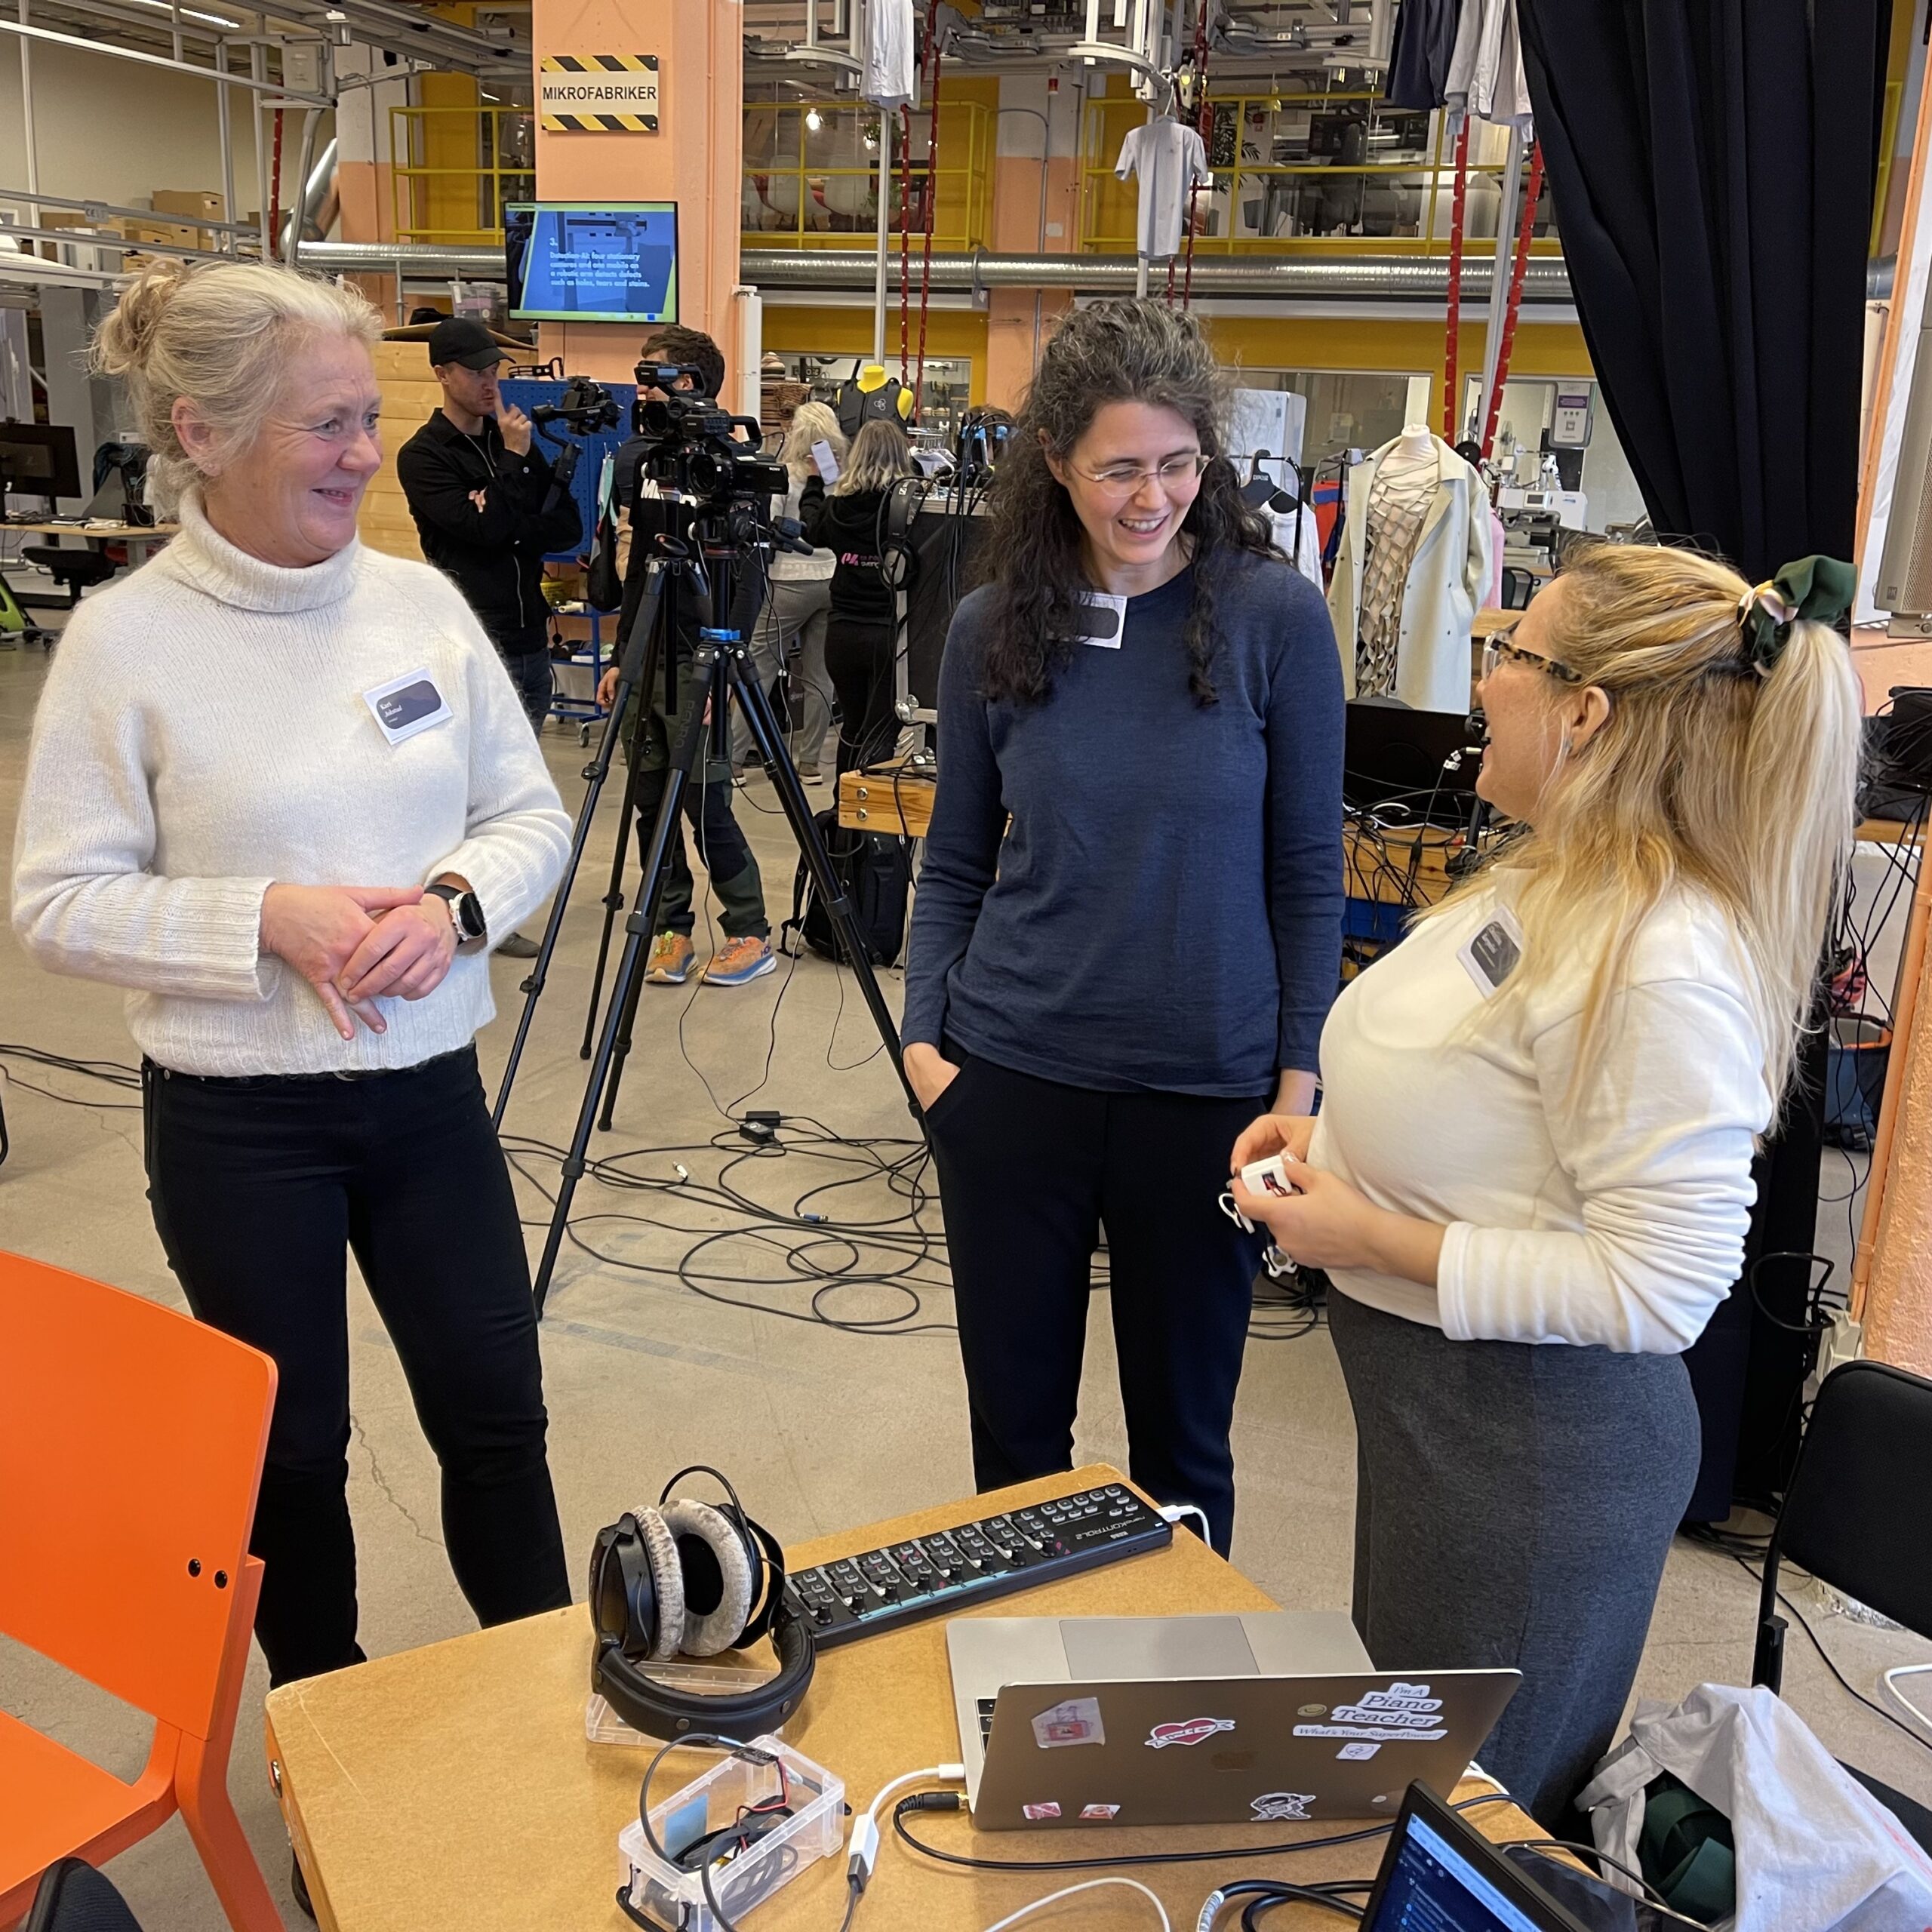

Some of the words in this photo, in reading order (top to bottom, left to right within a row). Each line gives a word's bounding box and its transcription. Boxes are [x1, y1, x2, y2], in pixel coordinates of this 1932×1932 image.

[543, 86, 657, 100] MIKROFABRIKER
[1415, 1687, 1424, 1696] A
[1364, 1695, 1436, 1710] Piano
[1338, 1709, 1438, 1726] Teacher
[1299, 1727, 1337, 1735] What's
[1340, 1728, 1366, 1737] Your
